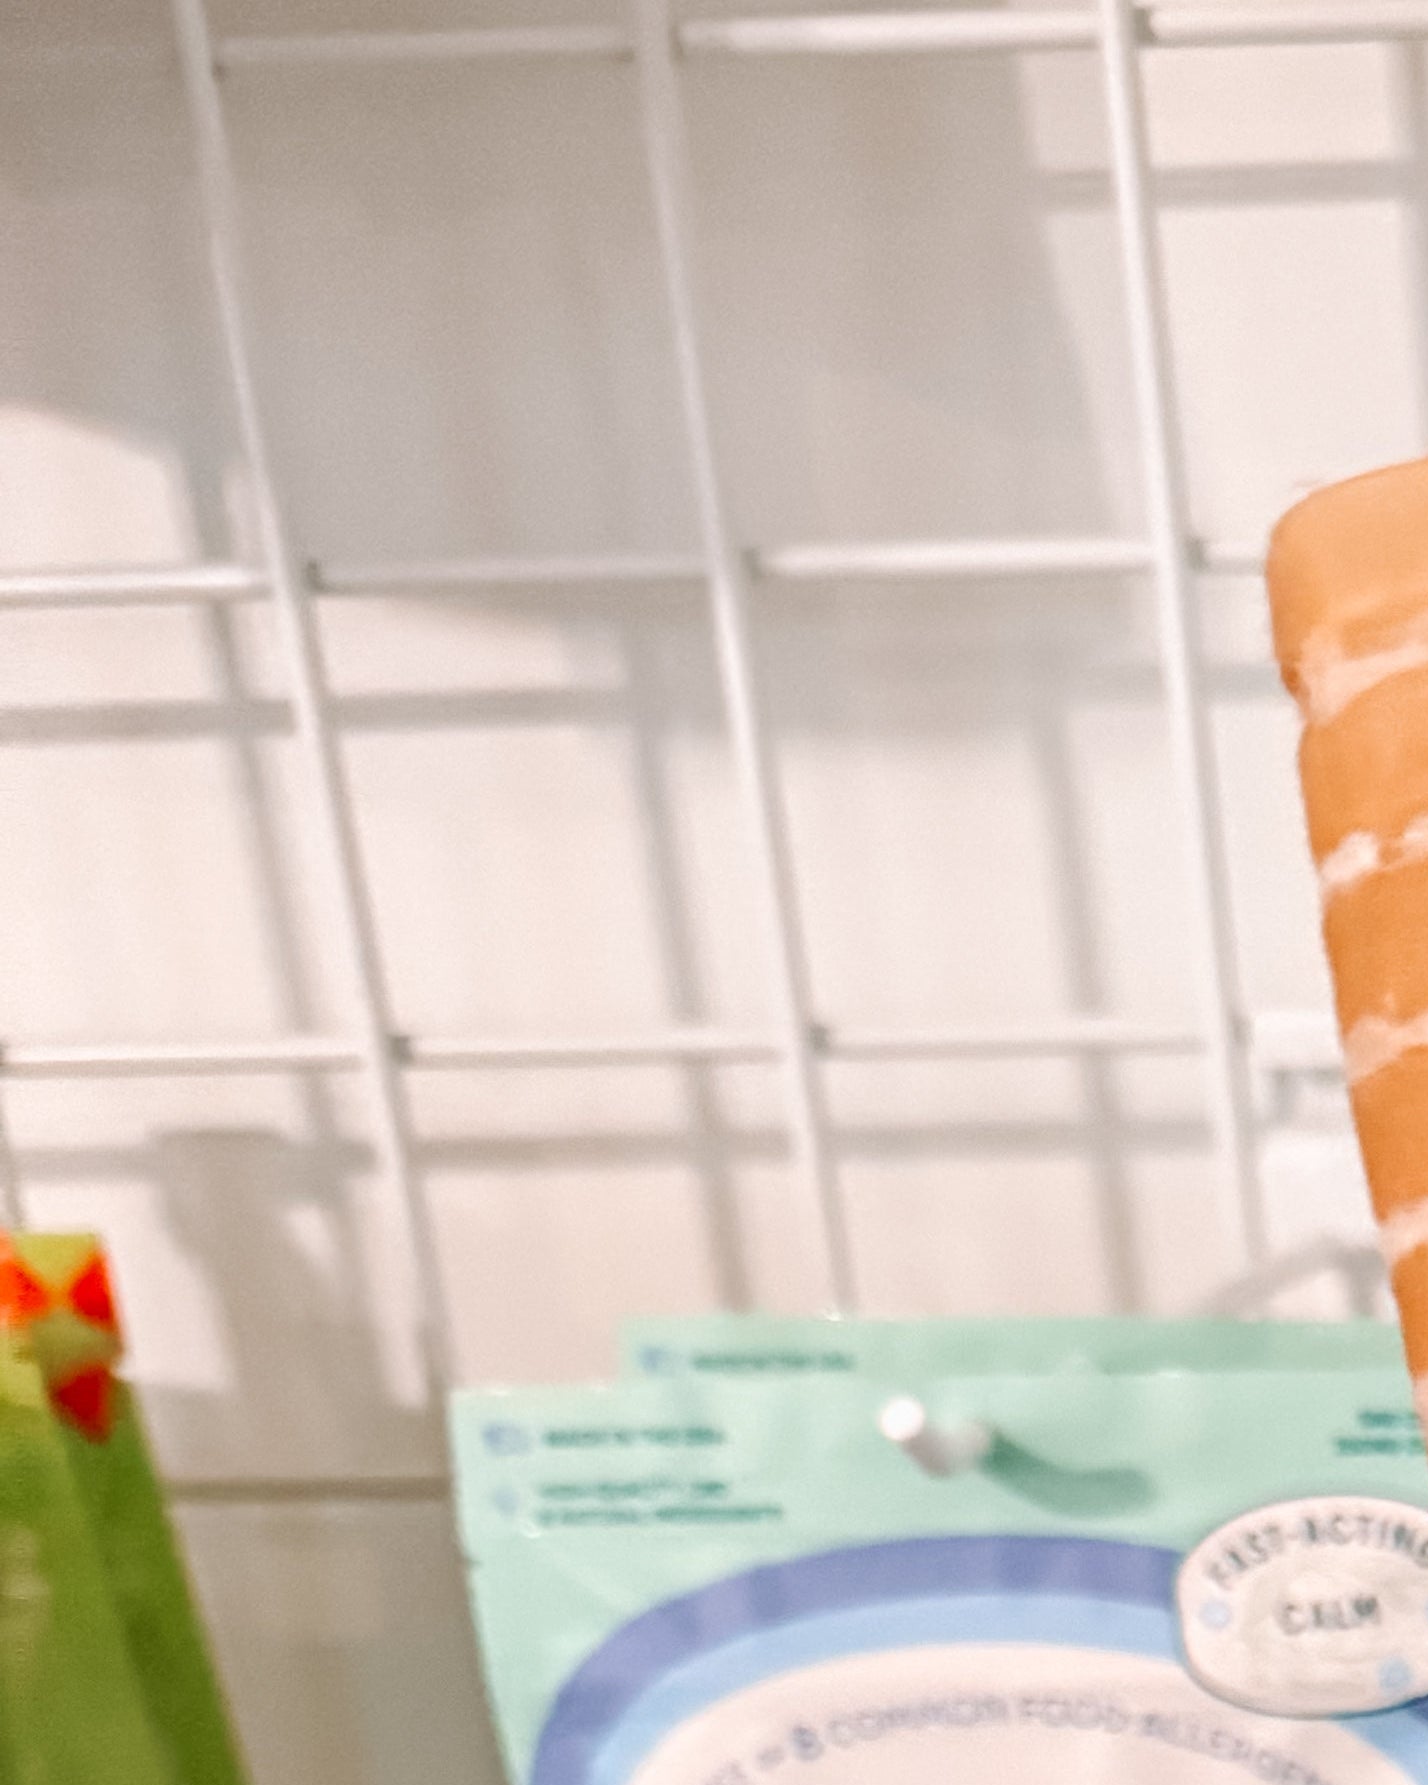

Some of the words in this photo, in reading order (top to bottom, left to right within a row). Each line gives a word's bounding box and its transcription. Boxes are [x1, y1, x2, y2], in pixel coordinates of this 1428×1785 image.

[1275, 1594, 1384, 1637] CALM
[825, 1694, 1010, 1748] COMMON
[1017, 1693, 1133, 1734] FOOD
